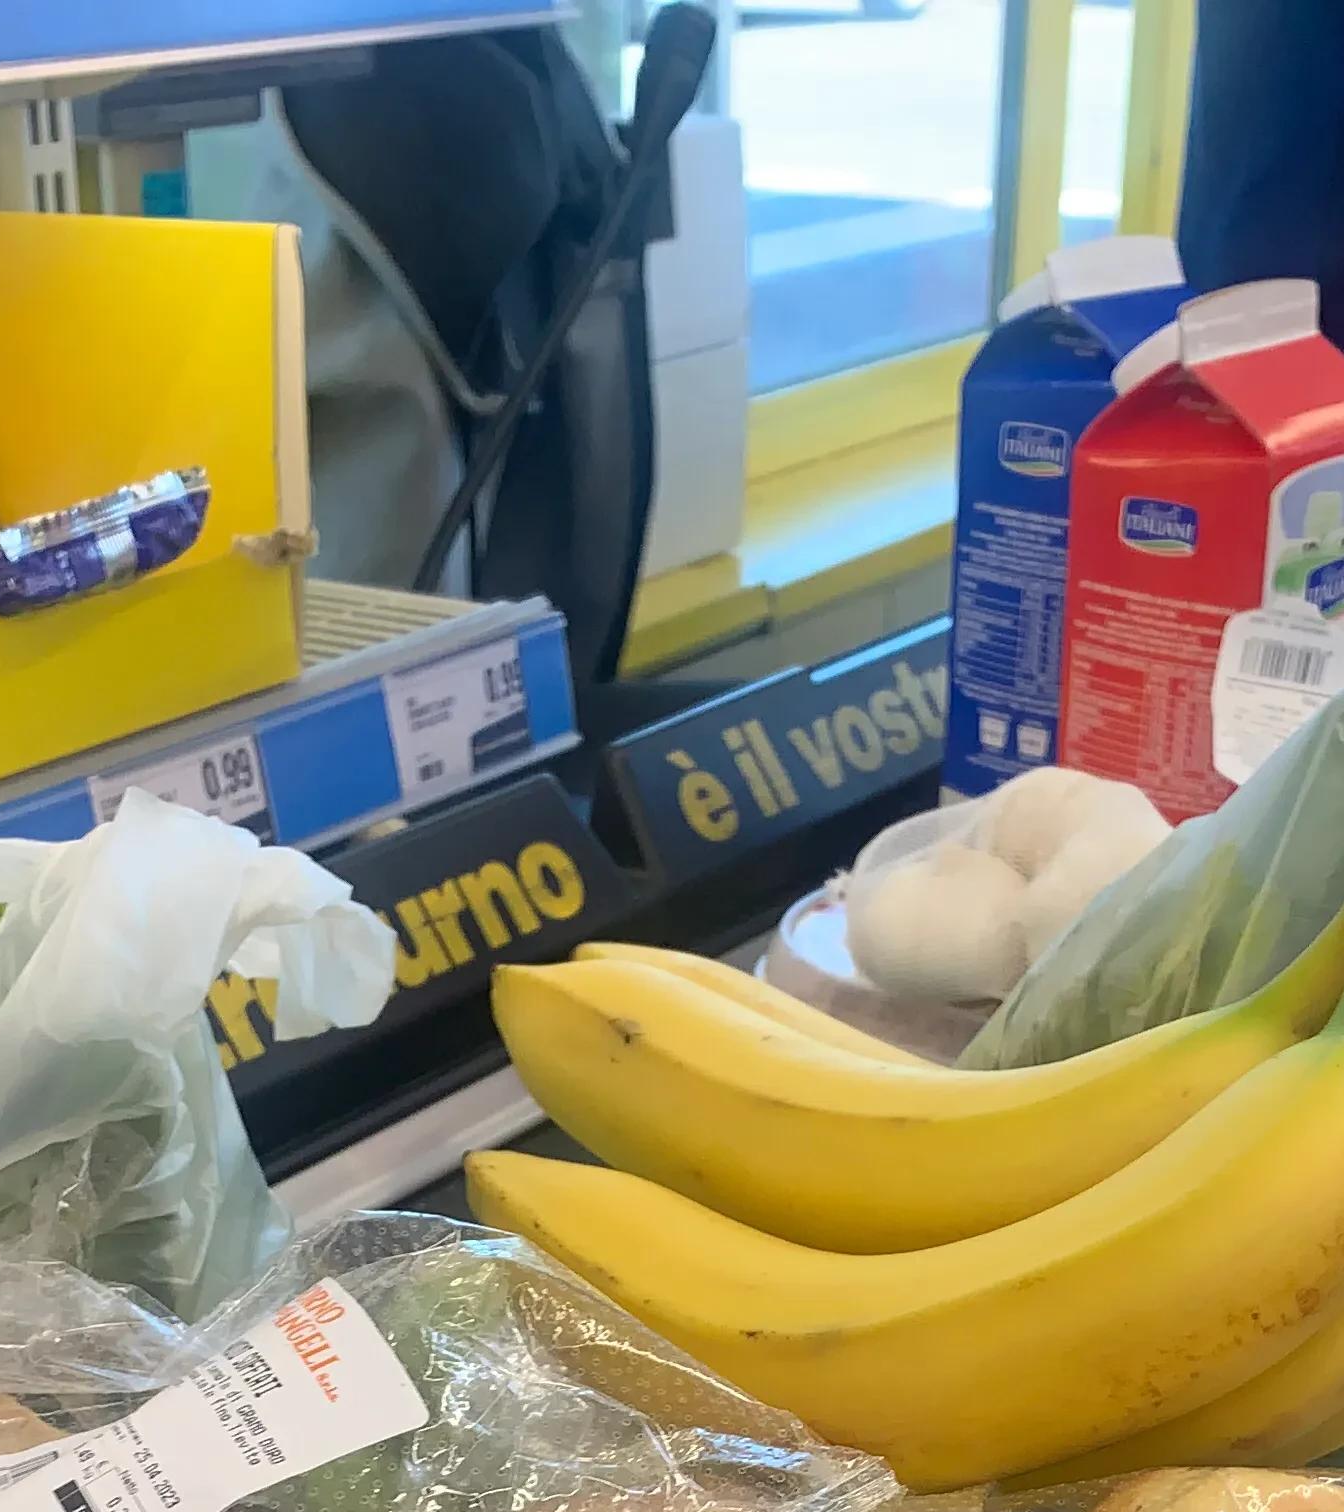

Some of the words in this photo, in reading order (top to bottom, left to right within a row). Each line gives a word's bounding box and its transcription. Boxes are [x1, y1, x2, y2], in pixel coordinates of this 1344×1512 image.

[665, 749, 740, 842] è
[720, 717, 800, 819] il
[133, 1447, 181, 1510] 25.04.2023
